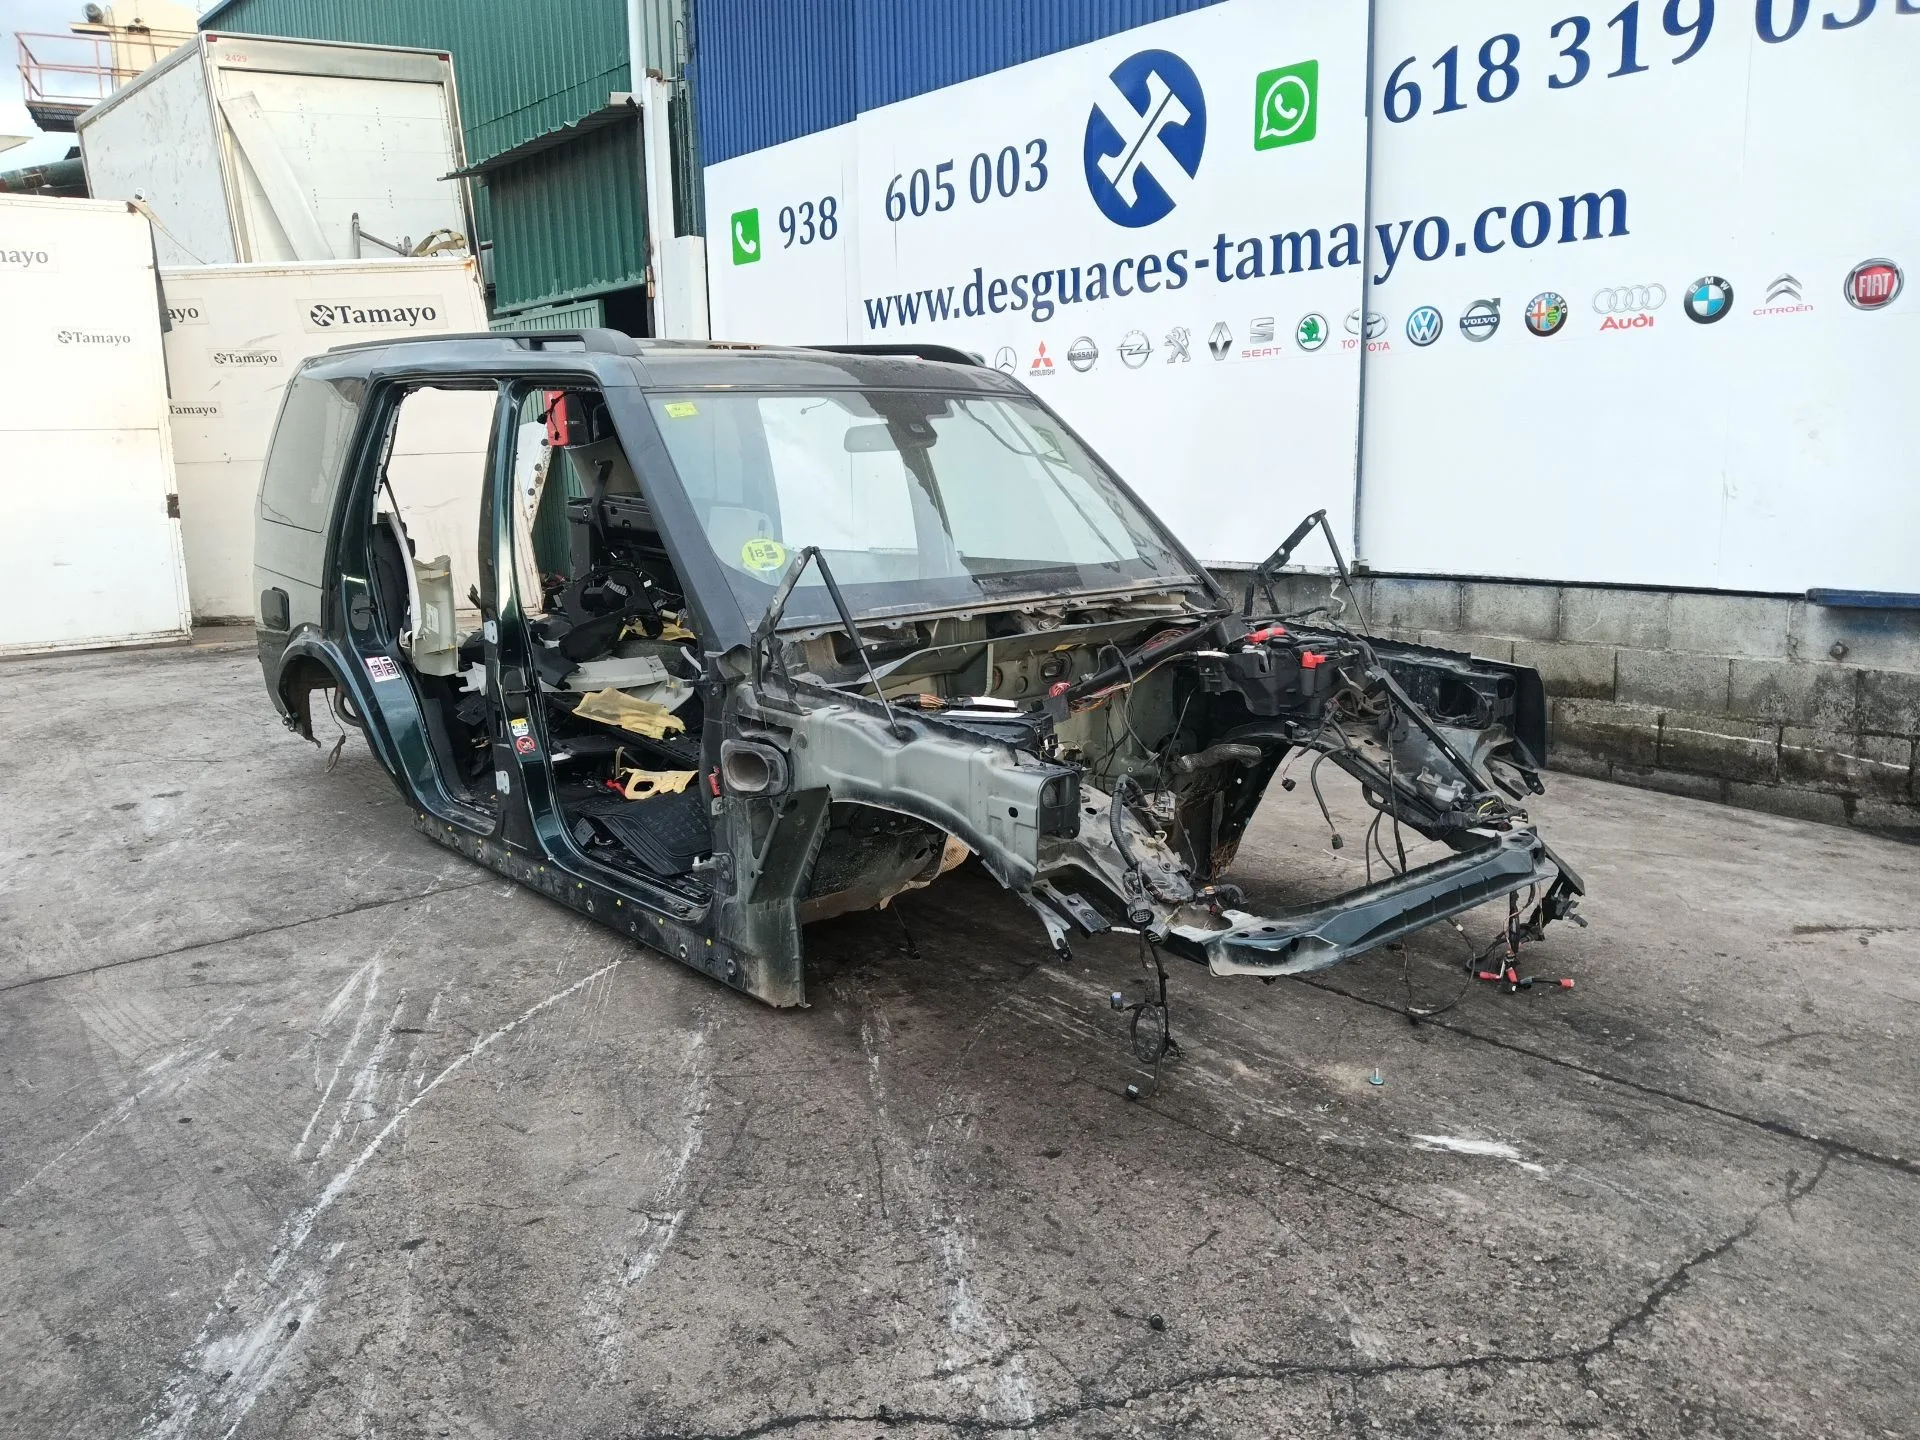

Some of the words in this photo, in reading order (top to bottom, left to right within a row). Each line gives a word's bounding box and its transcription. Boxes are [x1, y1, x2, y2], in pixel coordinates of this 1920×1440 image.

[1383, 33, 1521, 124] 618
[1548, 0, 1715, 90] 319
[778, 196, 838, 250] 938
[885, 158, 956, 222] 605
[969, 138, 1048, 204] 003
[864, 188, 1630, 331] www.desguaces-tamayo.com
[1689, 276, 1730, 294] BMW
[1858, 272, 1892, 298] FIAT
[334, 305, 436, 326] Tamayo
[1462, 315, 1498, 326] VOLVO
[1600, 315, 1654, 331] Audi
[72, 331, 131, 346] Tamayo
[227, 352, 278, 365] Tamayo
[1241, 347, 1282, 358] SEAT
